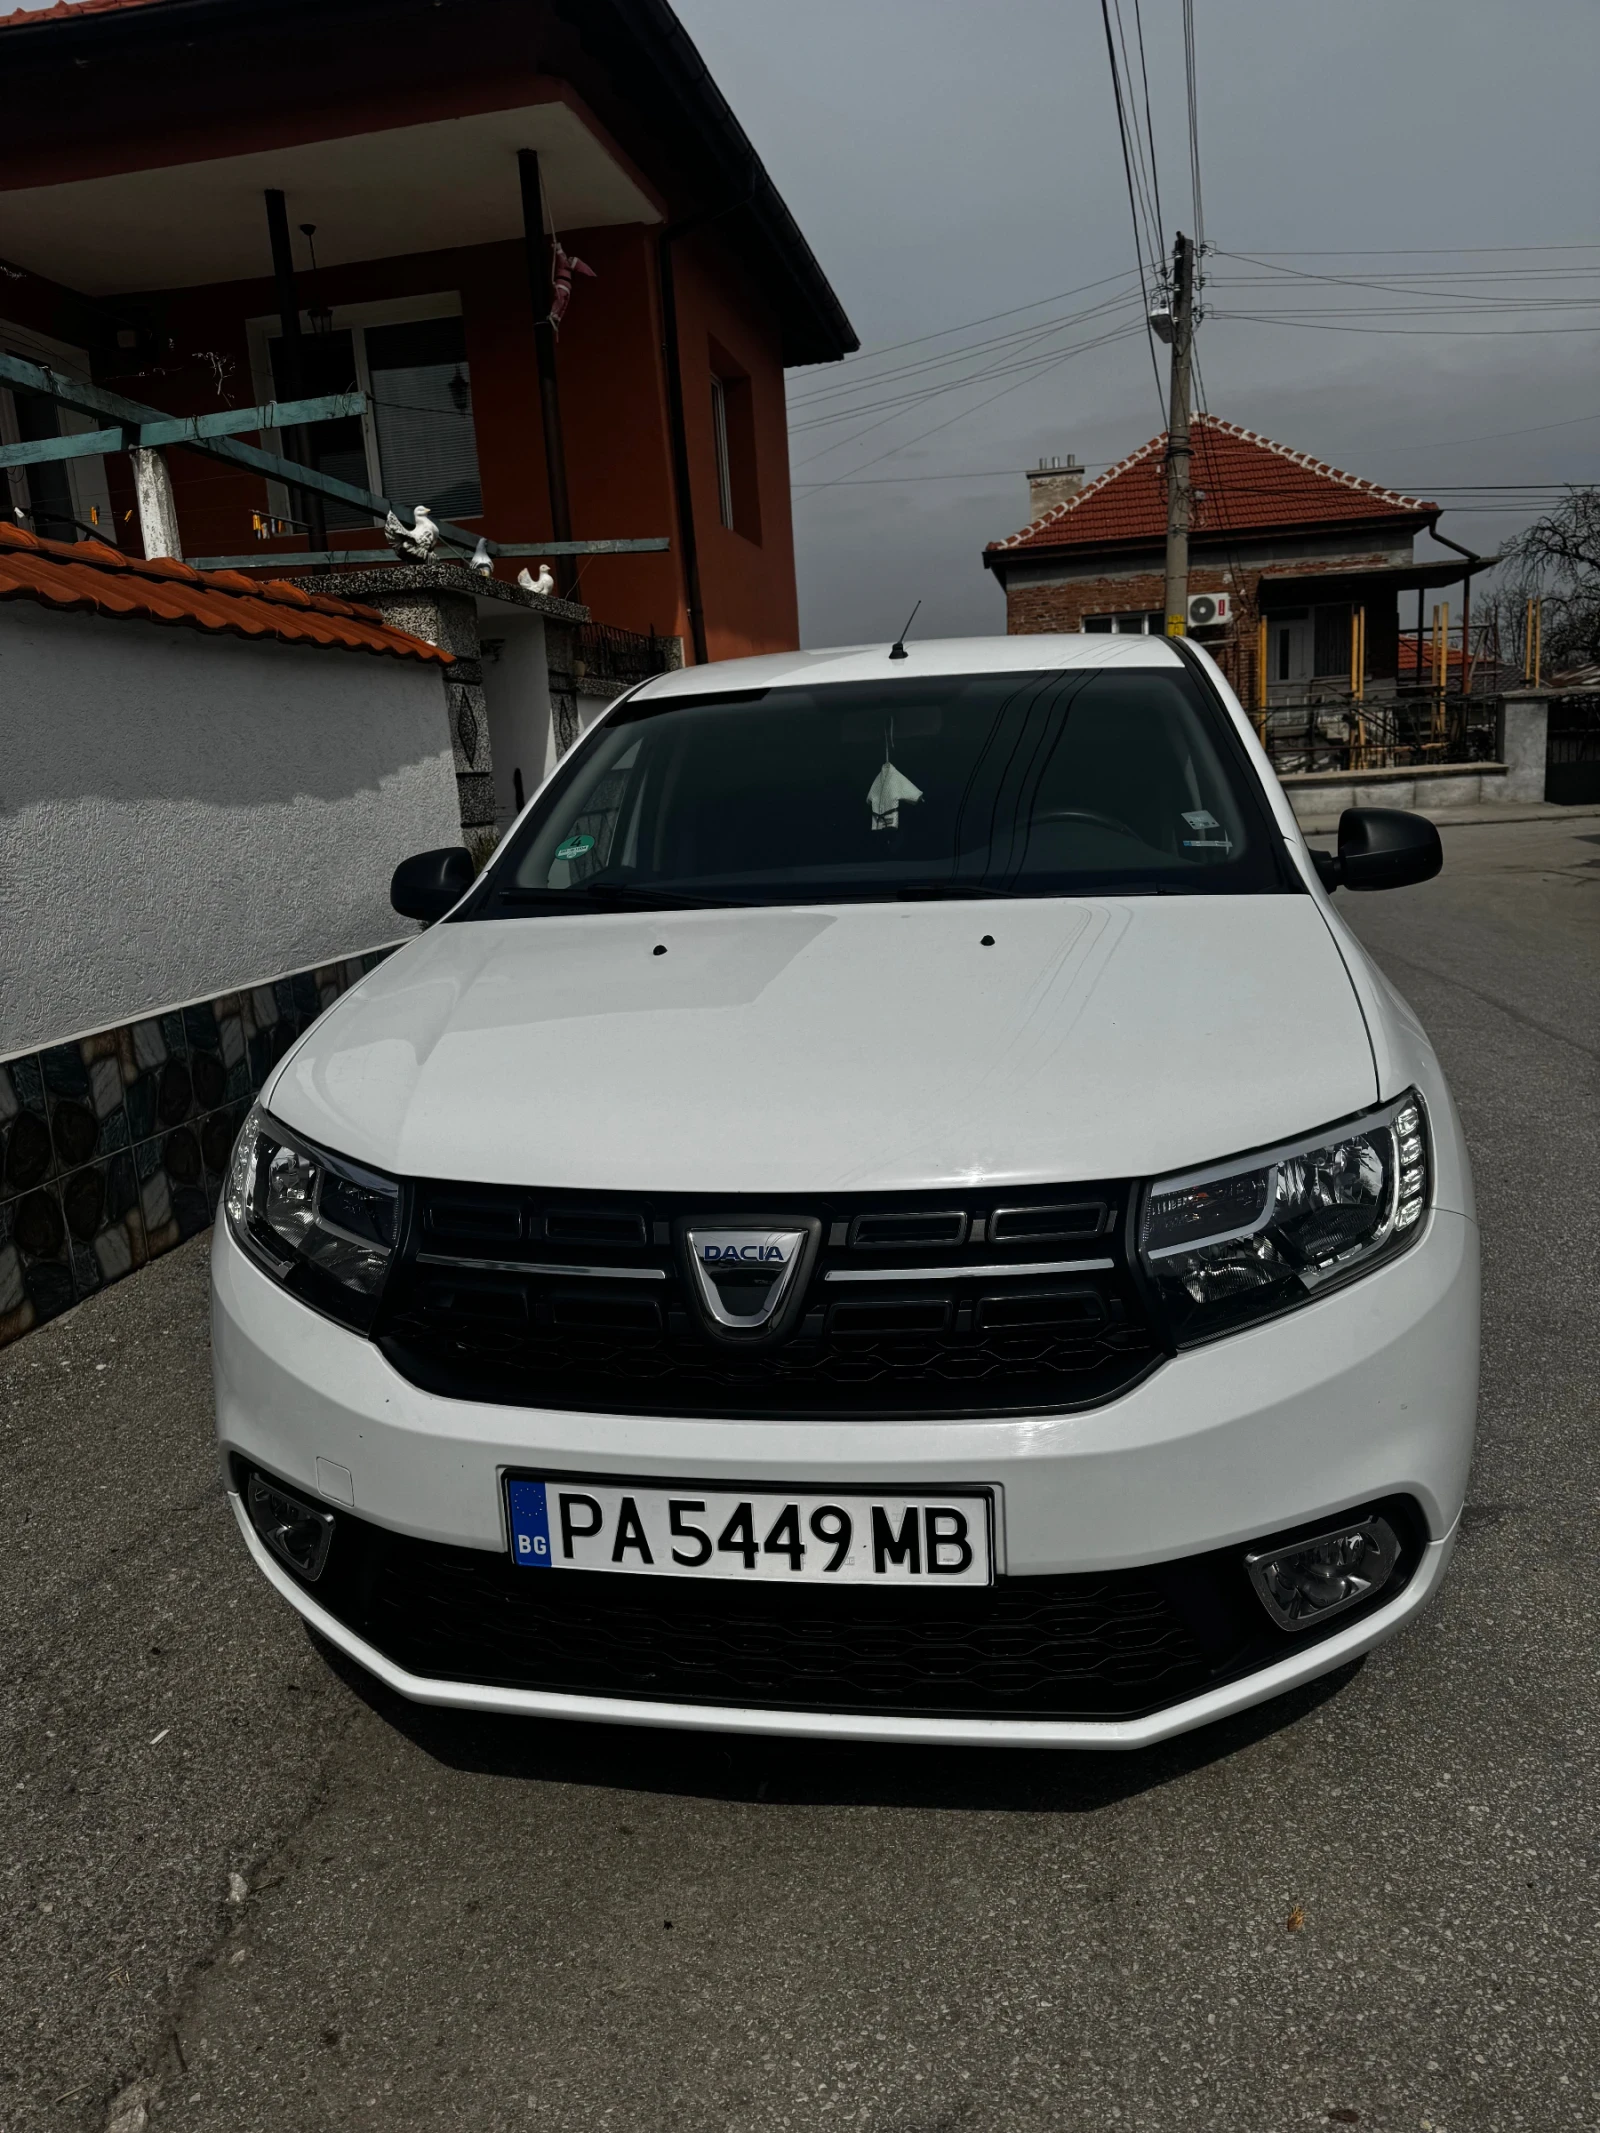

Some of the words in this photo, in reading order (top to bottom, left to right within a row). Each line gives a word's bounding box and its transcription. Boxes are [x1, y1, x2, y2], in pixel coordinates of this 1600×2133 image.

[570, 836, 582, 847] 4
[704, 1245, 784, 1261] DACIA
[558, 1492, 654, 1564] PA
[668, 1500, 853, 1572] 5449
[871, 1505, 973, 1575] MB
[518, 1534, 547, 1556] BG
